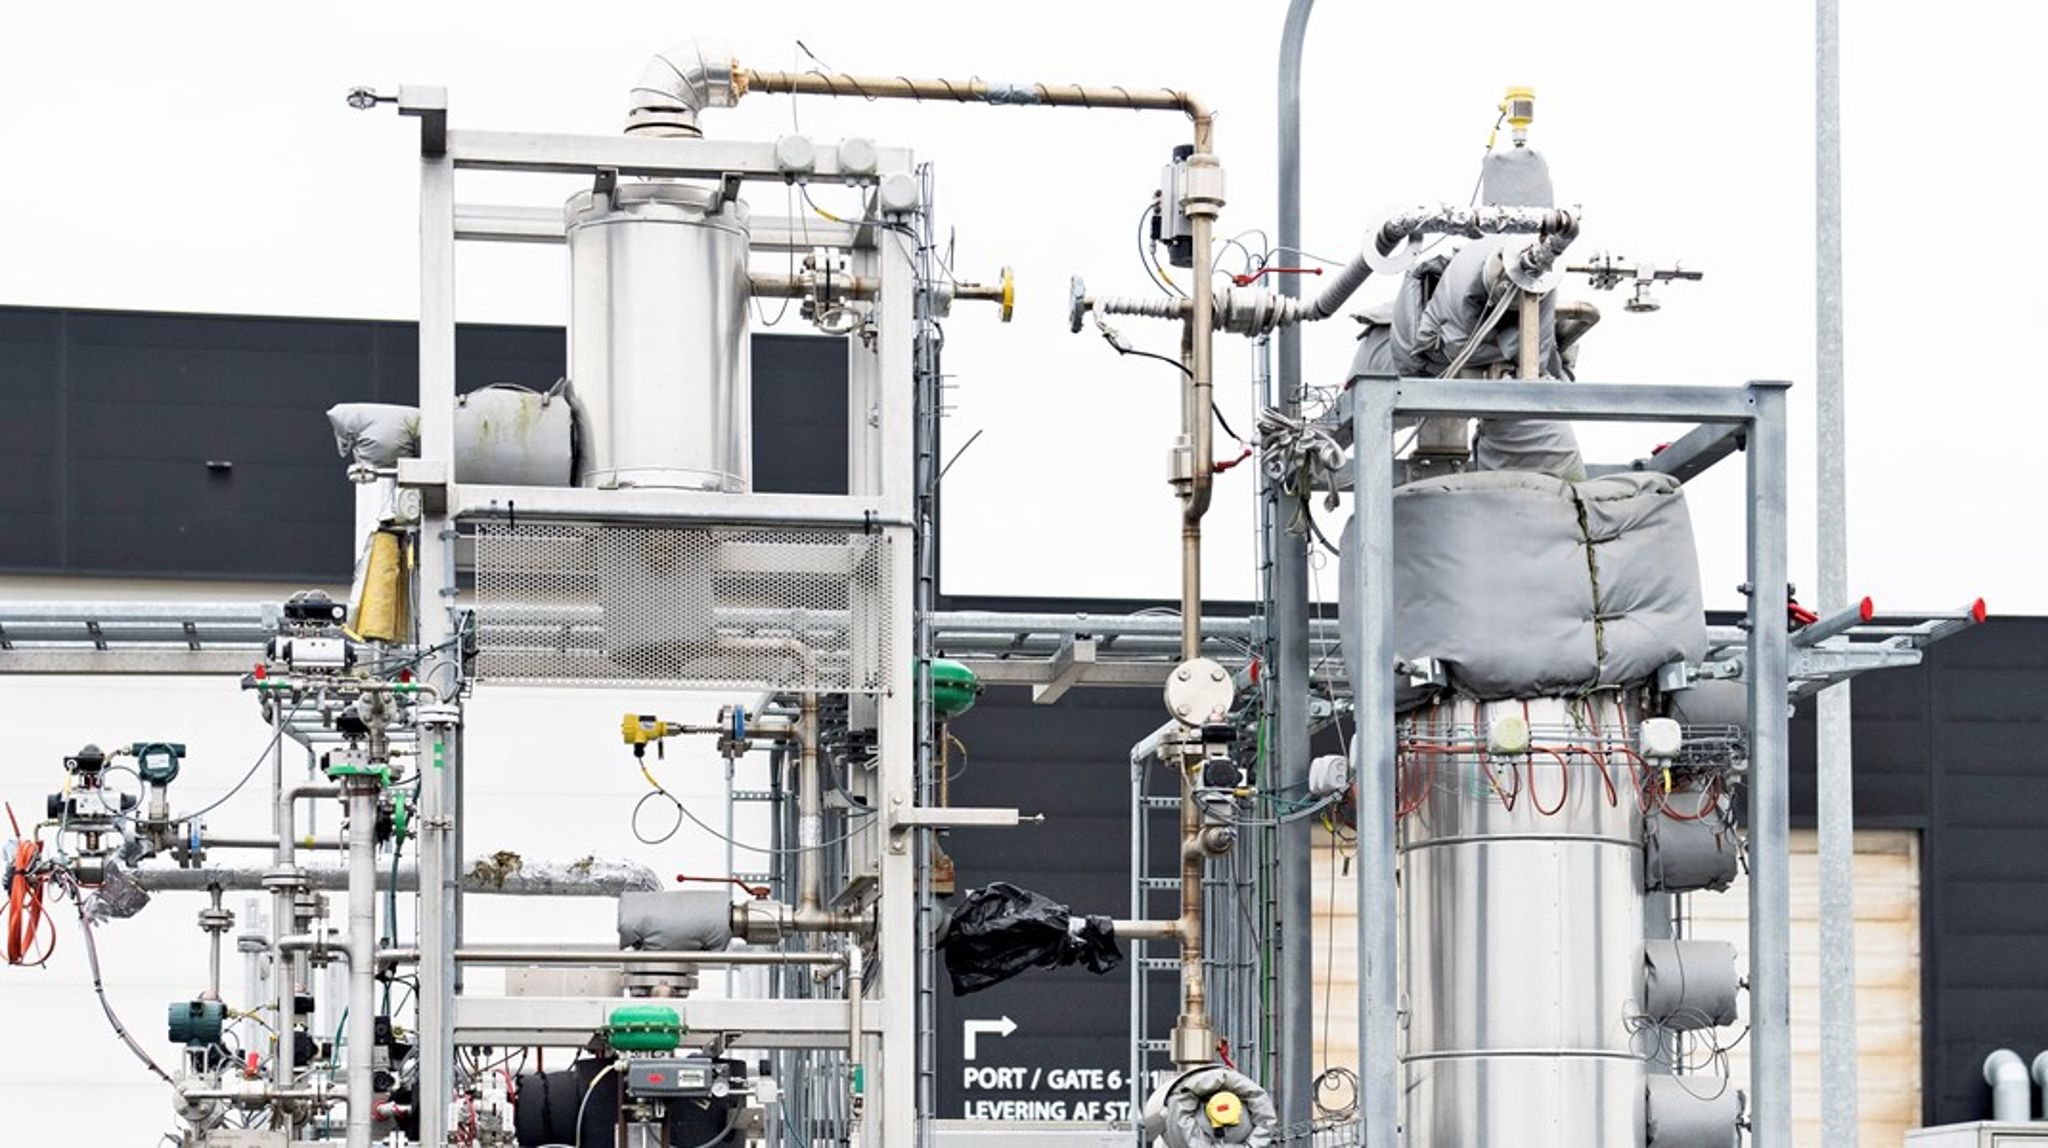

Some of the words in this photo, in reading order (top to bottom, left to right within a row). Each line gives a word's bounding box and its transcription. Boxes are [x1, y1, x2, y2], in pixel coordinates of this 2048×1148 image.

[964, 1067, 1028, 1089] PORT
[1031, 1068, 1042, 1091] /
[1047, 1069, 1104, 1090] GATE
[1107, 1070, 1122, 1090] 6
[964, 1101, 1067, 1119] LEVERING
[1073, 1102, 1101, 1119] AF
